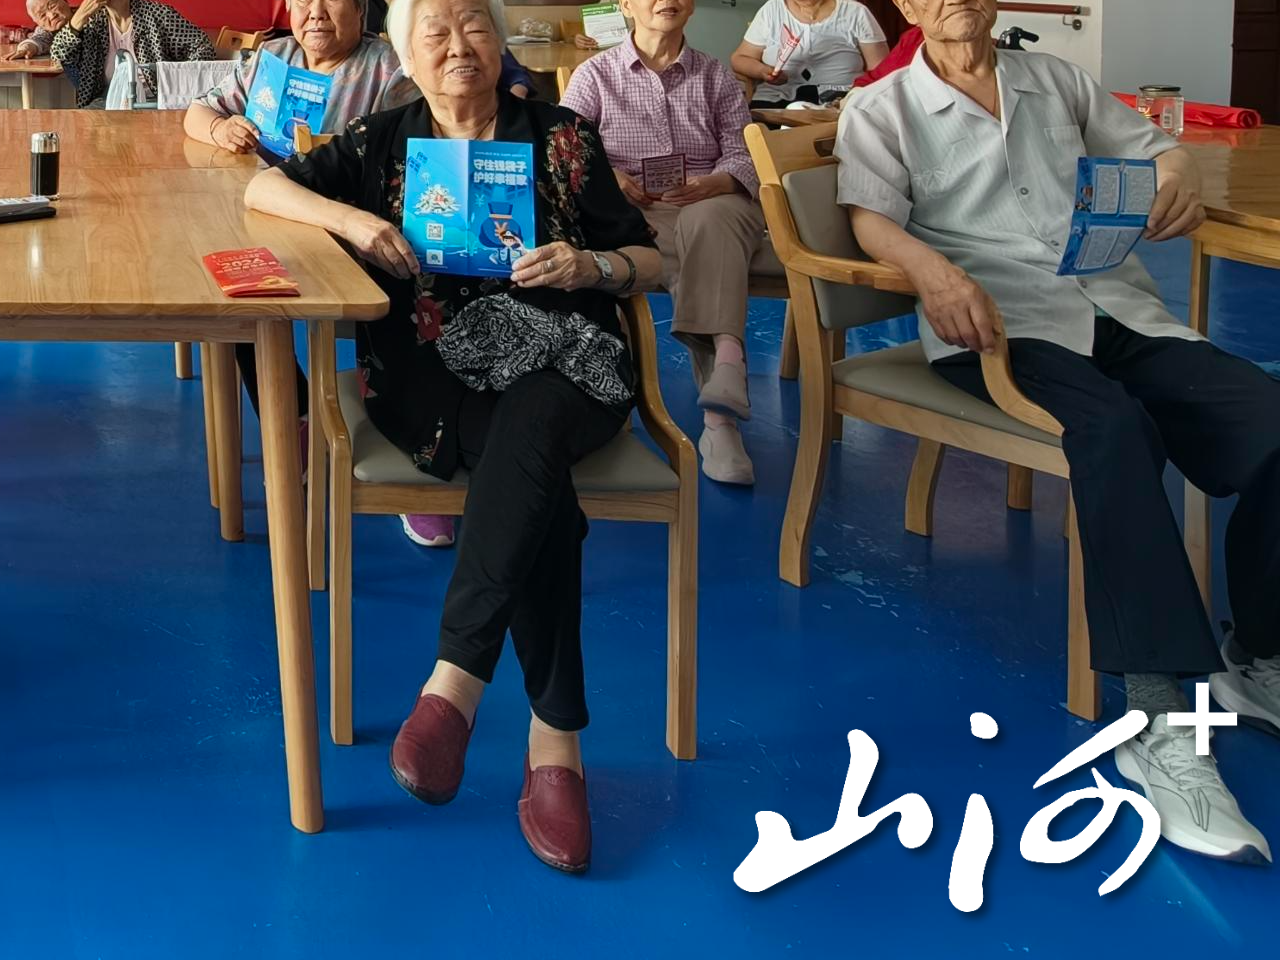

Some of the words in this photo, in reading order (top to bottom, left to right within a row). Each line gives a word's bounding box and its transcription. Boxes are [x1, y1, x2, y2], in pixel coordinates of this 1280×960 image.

[473, 159, 527, 173] 守住钱袋子
